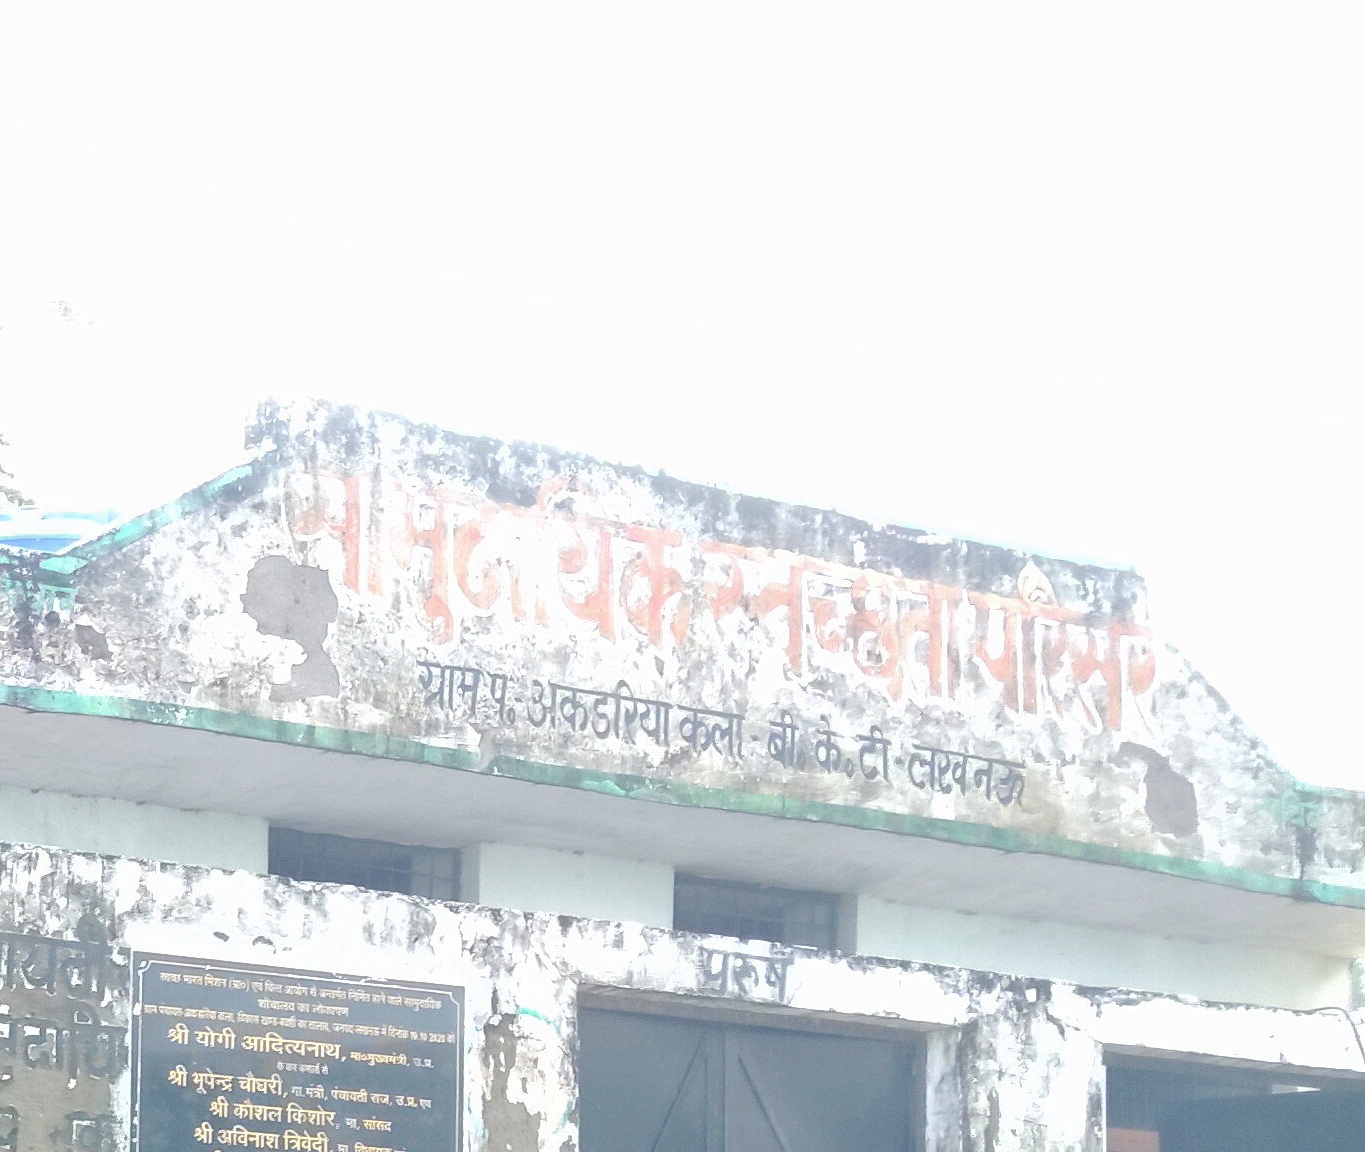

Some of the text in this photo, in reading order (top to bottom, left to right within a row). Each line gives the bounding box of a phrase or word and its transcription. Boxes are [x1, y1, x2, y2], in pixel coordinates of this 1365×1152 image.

[167, 1022, 190, 1045] श्री
[194, 1025, 236, 1050] योगी
[168, 1065, 188, 1087] श्री
[191, 1067, 234, 1094] भूपेन्द्र
[209, 1095, 229, 1118] श्री
[233, 1098, 283, 1122] कौशल
[194, 1122, 213, 1144] श्री
[217, 1125, 280, 1149] अविनाश
